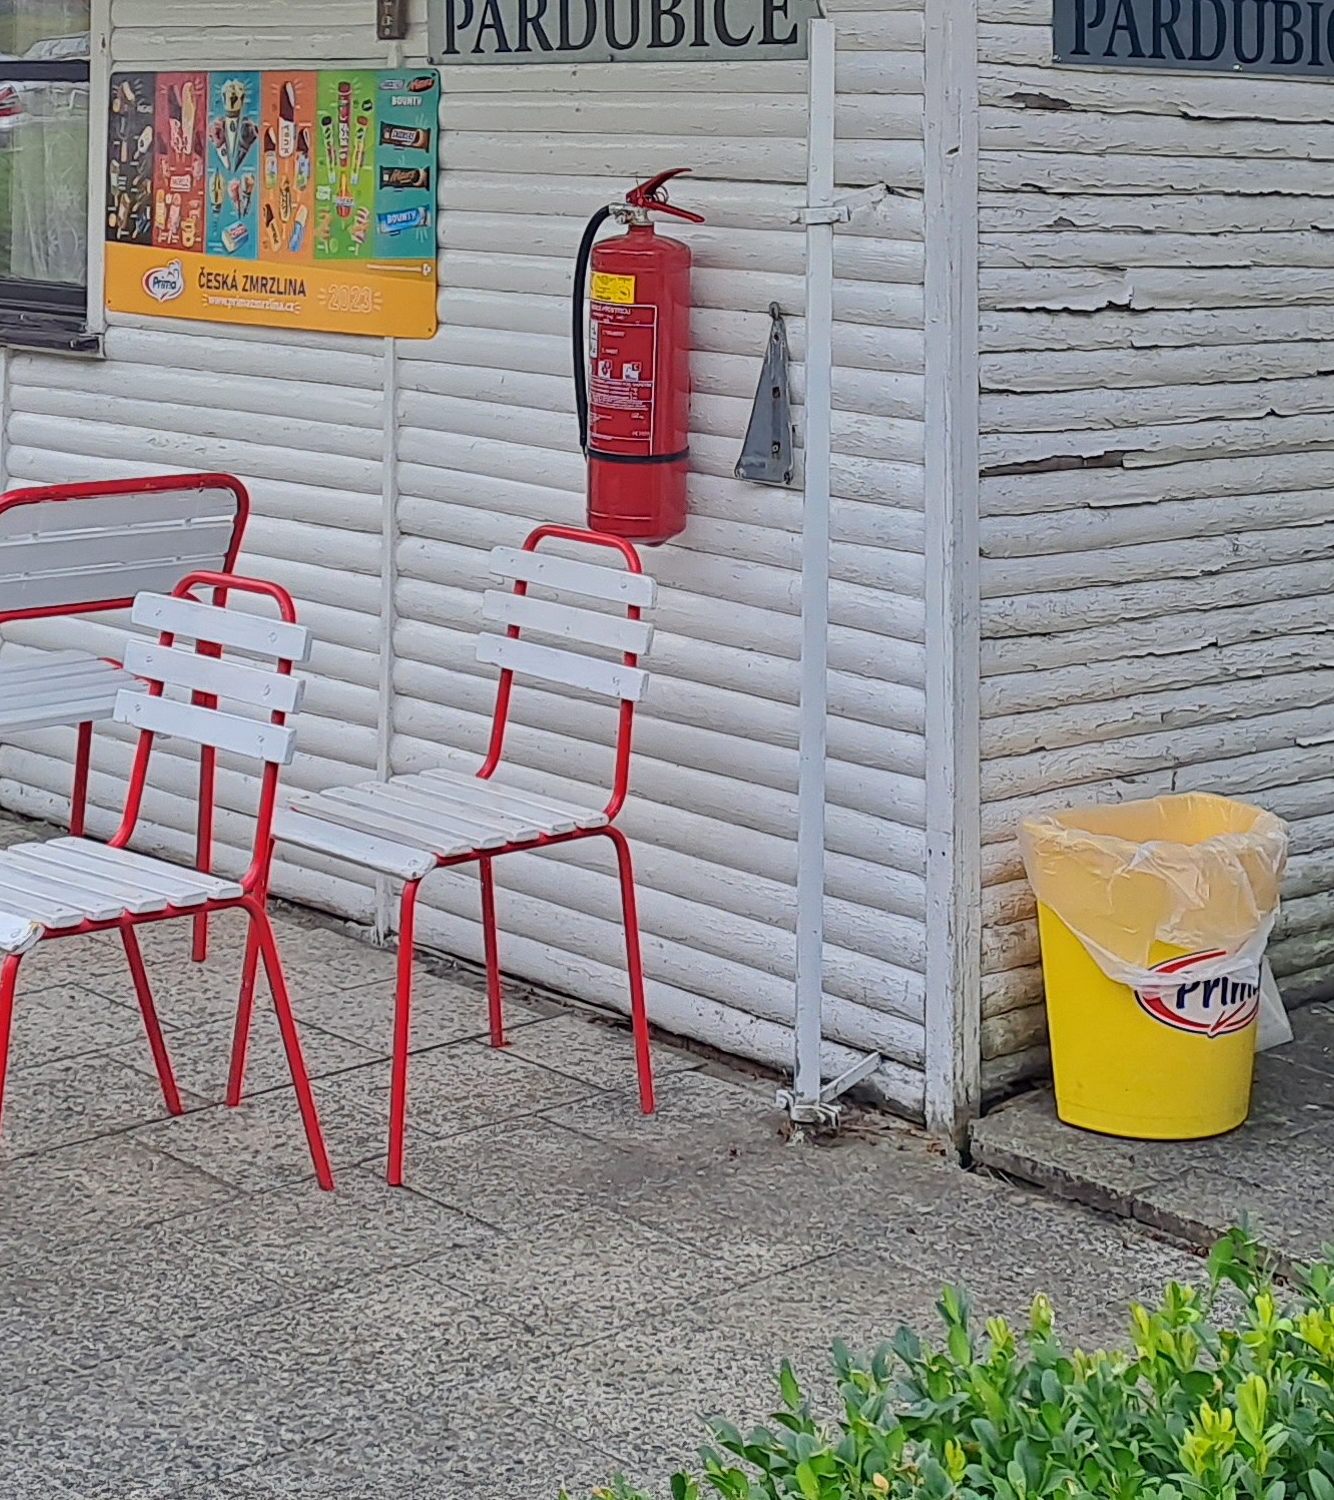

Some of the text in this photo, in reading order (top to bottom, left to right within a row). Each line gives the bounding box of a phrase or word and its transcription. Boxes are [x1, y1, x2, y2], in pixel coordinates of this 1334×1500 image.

[391, 95, 422, 107] BOUNTY
[386, 209, 416, 225] BOUNTY
[152, 276, 177, 291] Prima
[198, 267, 307, 297] ČESKÁ ZMRZLINA
[327, 283, 373, 313] 2023
[1176, 977, 1259, 1010] Prim
